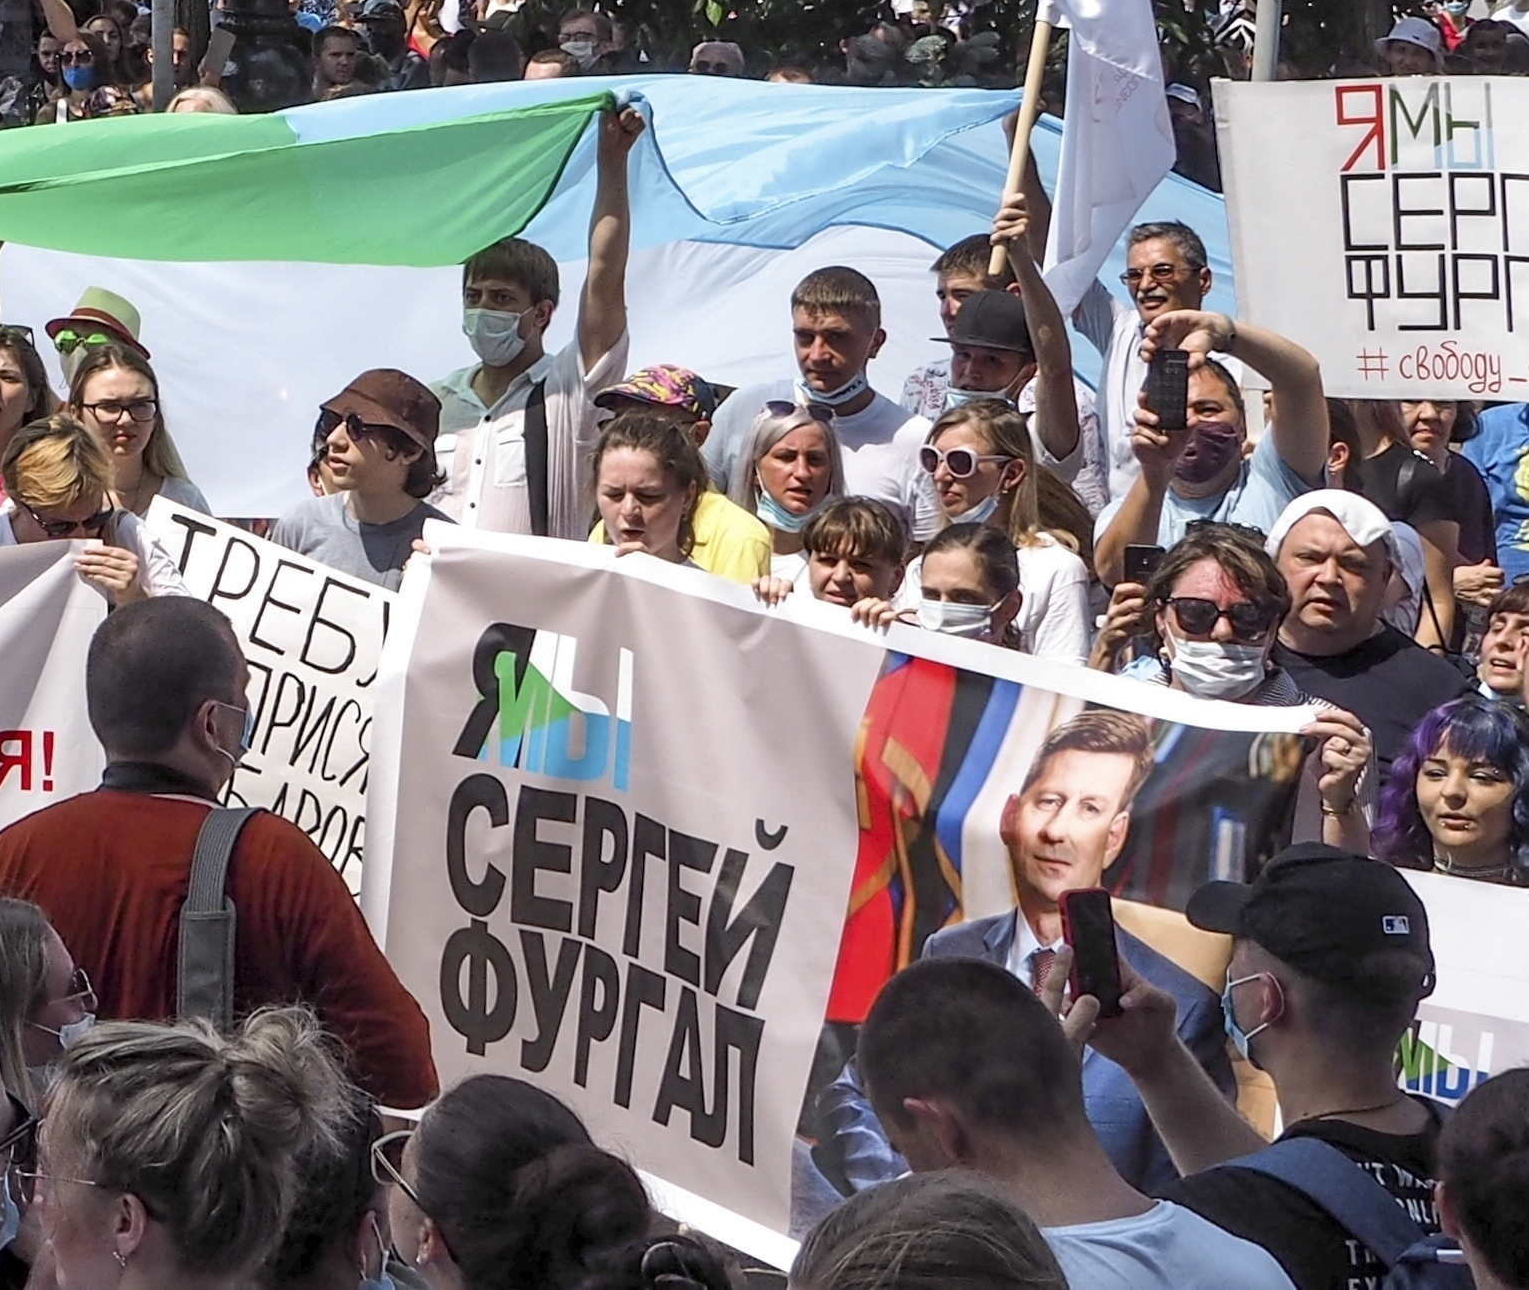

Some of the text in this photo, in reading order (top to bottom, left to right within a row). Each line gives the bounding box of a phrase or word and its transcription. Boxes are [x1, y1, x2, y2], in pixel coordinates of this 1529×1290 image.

[1335, 81, 1495, 171] ЯМЫ
[446, 773, 796, 1012] СЕРГЕЙ
[440, 917, 766, 1167] ФУРГАЛ
